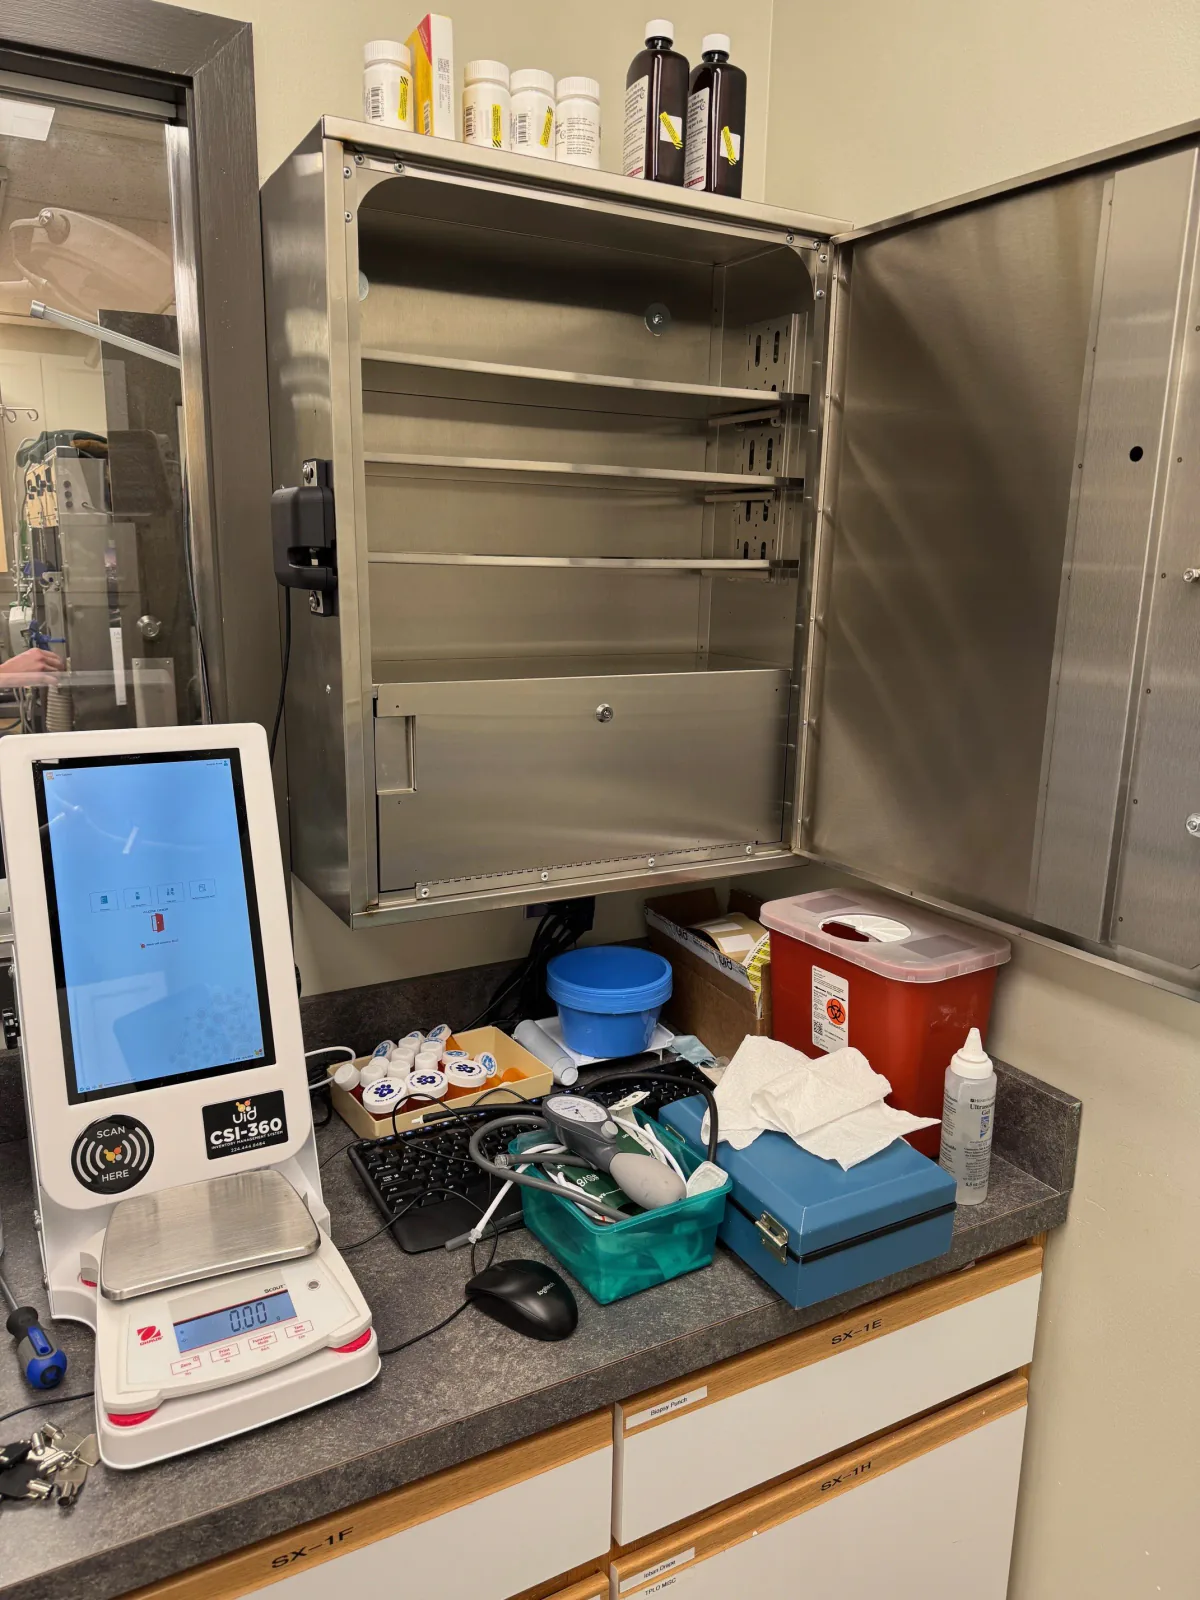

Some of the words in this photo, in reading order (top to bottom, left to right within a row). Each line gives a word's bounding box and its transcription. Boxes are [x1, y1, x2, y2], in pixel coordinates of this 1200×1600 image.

[97, 1126, 126, 1139] SCAN
[210, 1117, 282, 1146] CSI-360
[211, 1141, 236, 1150] INVENTORY
[236, 1134, 266, 1144] MANAGEMENT
[101, 1169, 130, 1182] HERE
[229, 1301, 268, 1332] 0.00
[831, 1319, 882, 1345] SX-1E
[650, 1404, 670, 1416] Biopsy
[670, 1397, 688, 1408] Punch
[821, 1461, 871, 1491] SX-1H
[271, 1526, 354, 1569] SX-1F
[660, 1560, 676, 1571] Drape
[645, 1584, 661, 1596] TPLO
[661, 1577, 677, 1588] MISC
